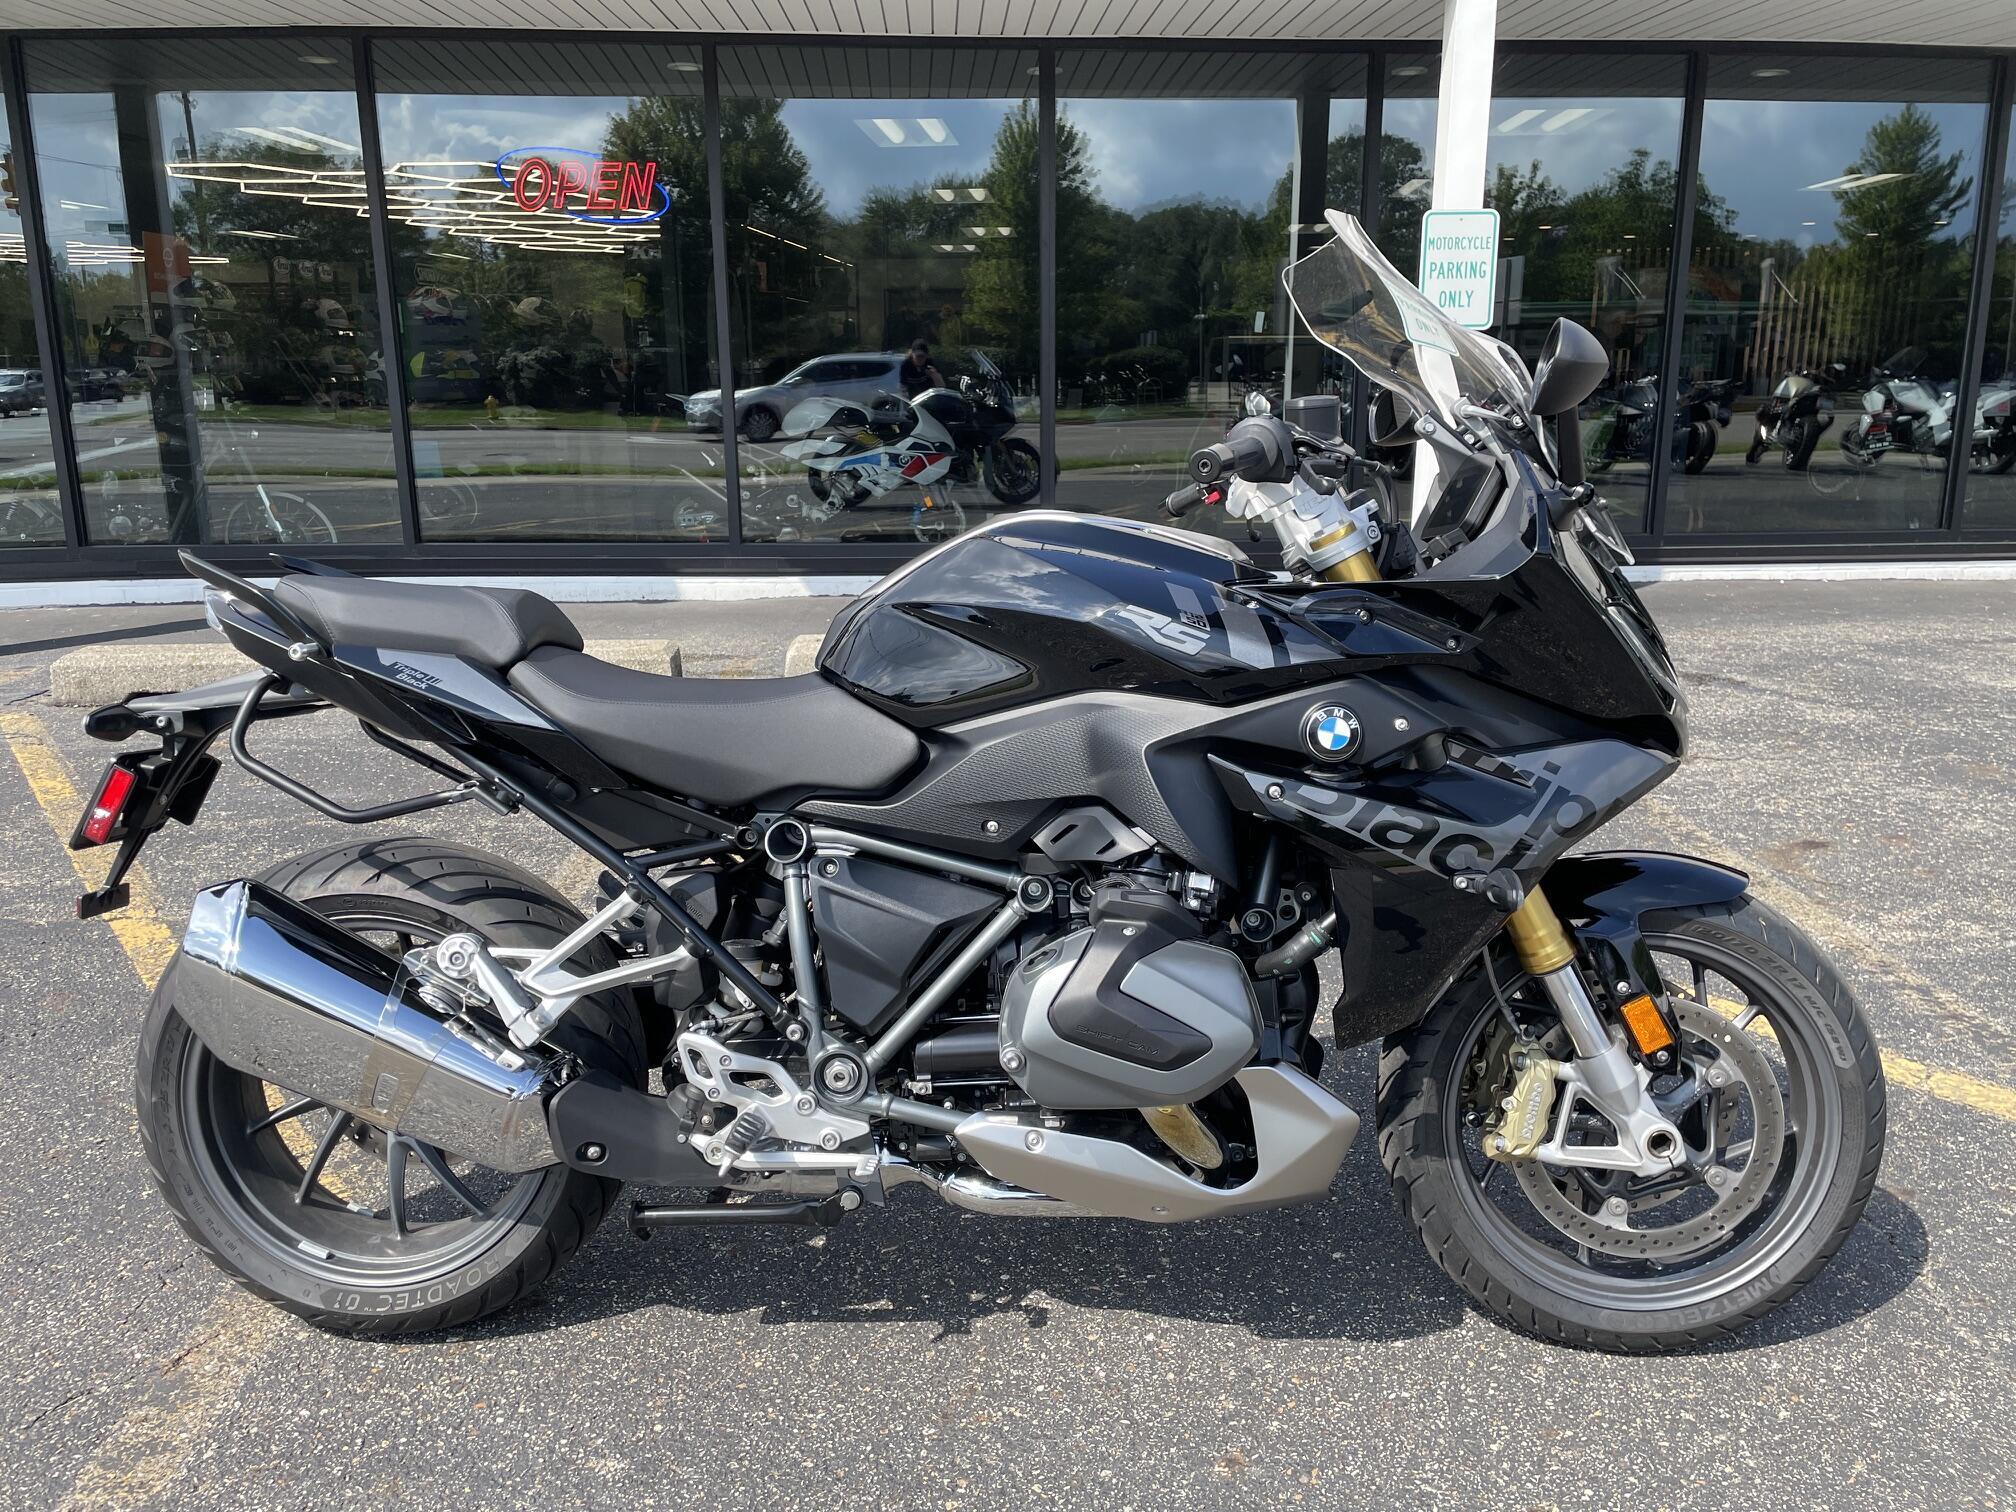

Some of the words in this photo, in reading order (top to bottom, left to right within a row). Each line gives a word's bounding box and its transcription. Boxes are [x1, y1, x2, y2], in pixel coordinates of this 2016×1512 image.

[513, 157, 657, 212] OPEN
[1428, 236, 1492, 250] MOTORCYCLE
[1429, 261, 1487, 280] PARKING
[1439, 290, 1474, 308] ONLY
[1115, 604, 1211, 656] RS
[392, 661, 425, 680] Triple
[395, 672, 429, 690] Black
[1316, 708, 1359, 729] BMW
[1074, 1024, 1124, 1043] SHIFT
[1127, 1040, 1160, 1056] CAM
[375, 1254, 502, 1312] ROADTEC
